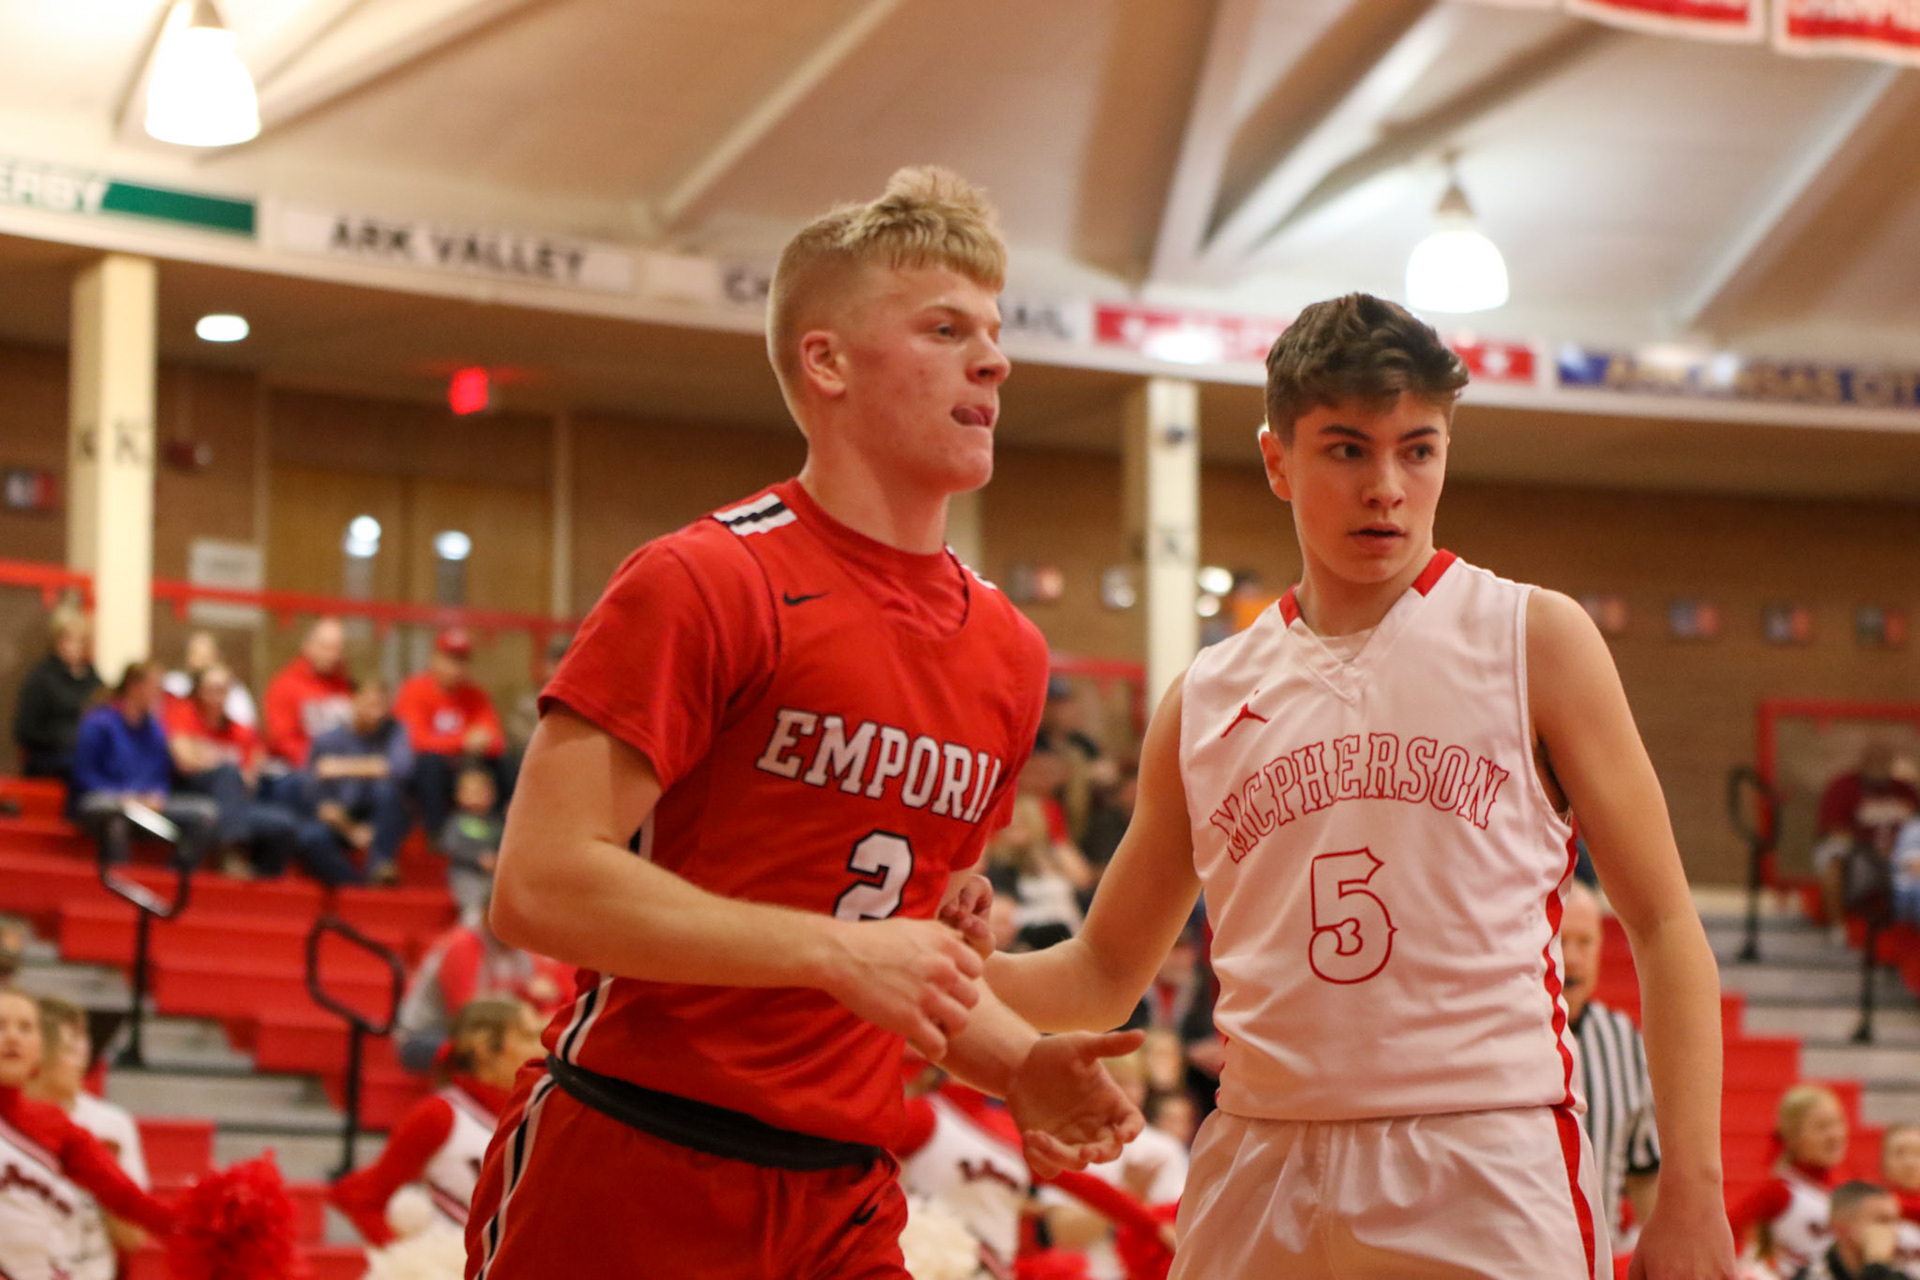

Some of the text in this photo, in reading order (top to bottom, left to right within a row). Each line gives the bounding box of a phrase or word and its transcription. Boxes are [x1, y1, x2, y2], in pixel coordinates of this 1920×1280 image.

[330, 217, 586, 283] ARK VALLEY
[1210, 733, 1510, 864] MCPHERSON
[831, 829, 914, 923] 2
[1308, 846, 1398, 985] 5
